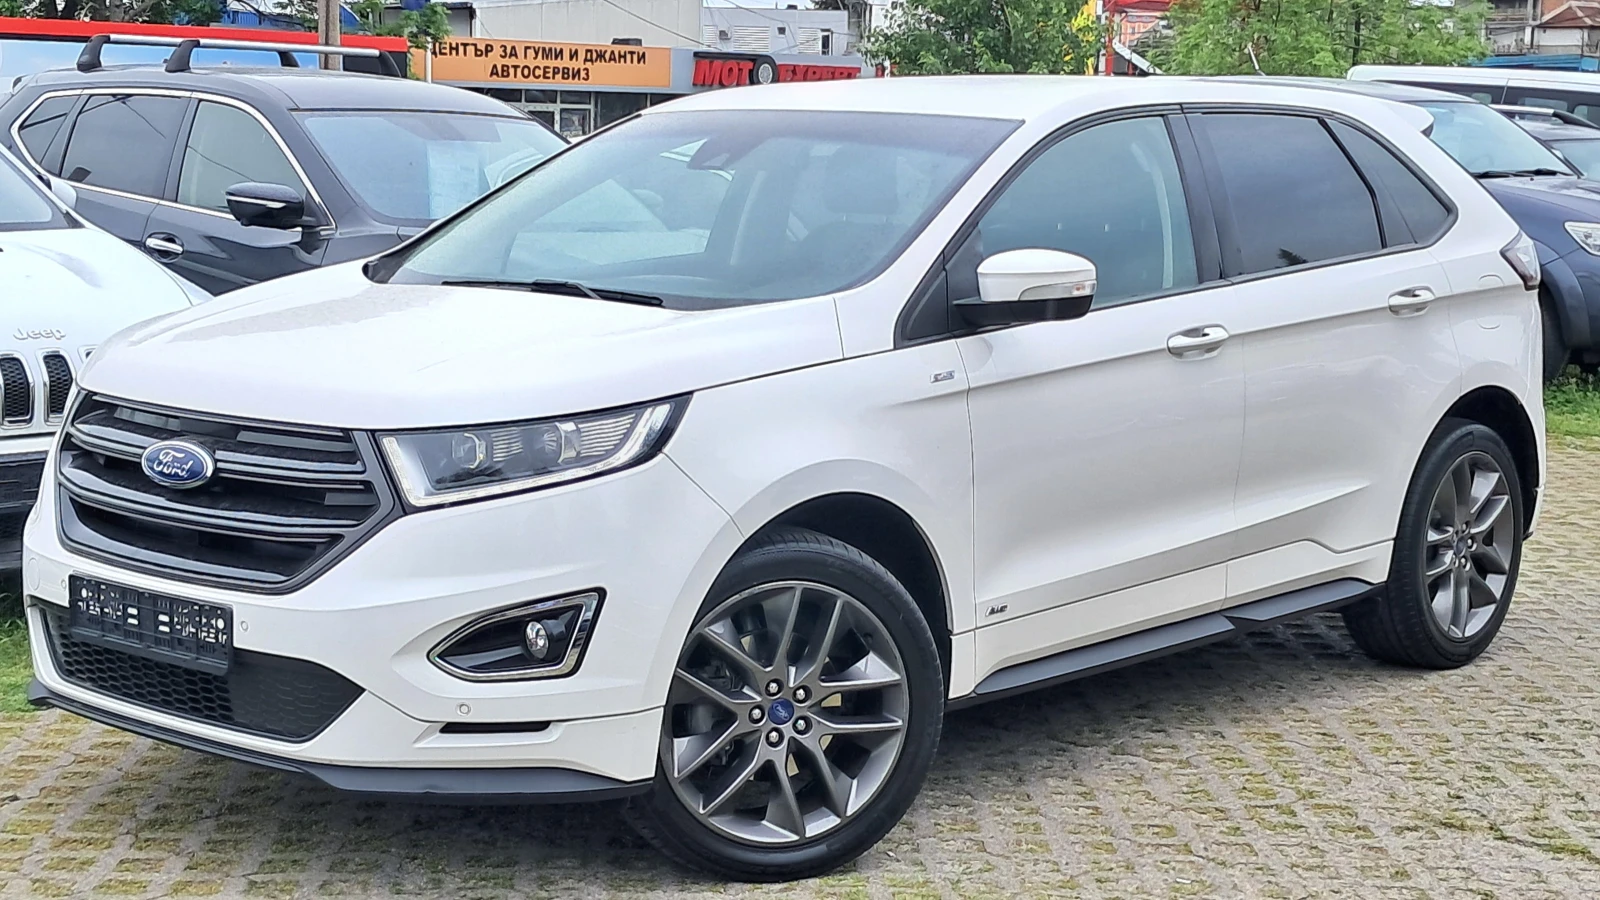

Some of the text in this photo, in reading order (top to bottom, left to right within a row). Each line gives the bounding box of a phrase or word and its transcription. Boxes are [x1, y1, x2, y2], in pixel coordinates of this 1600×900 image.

[499, 44, 518, 60] ЗА
[523, 45, 564, 61] ГУМИ
[569, 48, 579, 62] И
[583, 48, 646, 66] ДЖАНТИ
[489, 63, 590, 81] АВТОСЕРВИЗ
[13, 327, 66, 341] Jeep
[153, 449, 194, 478] Ford
